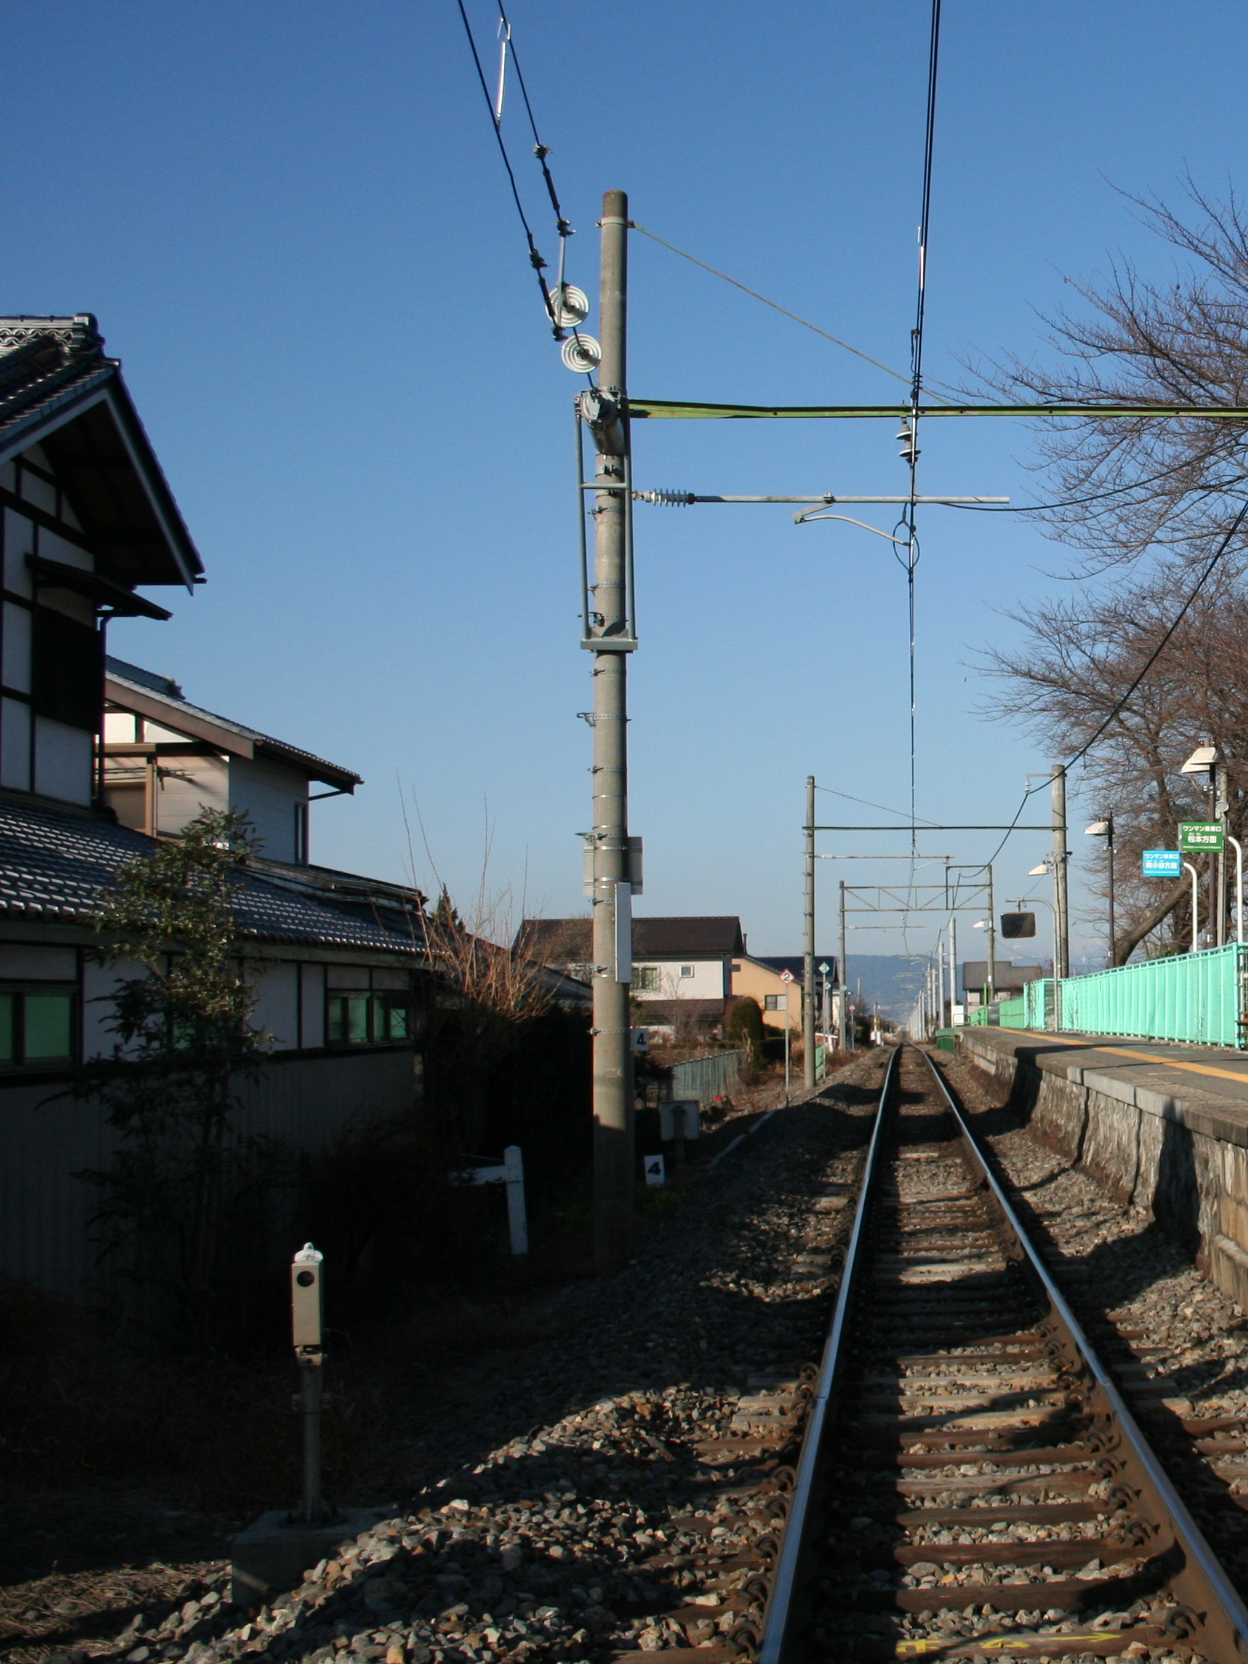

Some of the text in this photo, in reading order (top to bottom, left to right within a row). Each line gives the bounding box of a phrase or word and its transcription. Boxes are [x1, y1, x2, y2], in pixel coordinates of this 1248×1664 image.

[783, 973, 790, 981] 2
[636, 1032, 646, 1045] 4
[647, 1161, 662, 1175] 4
